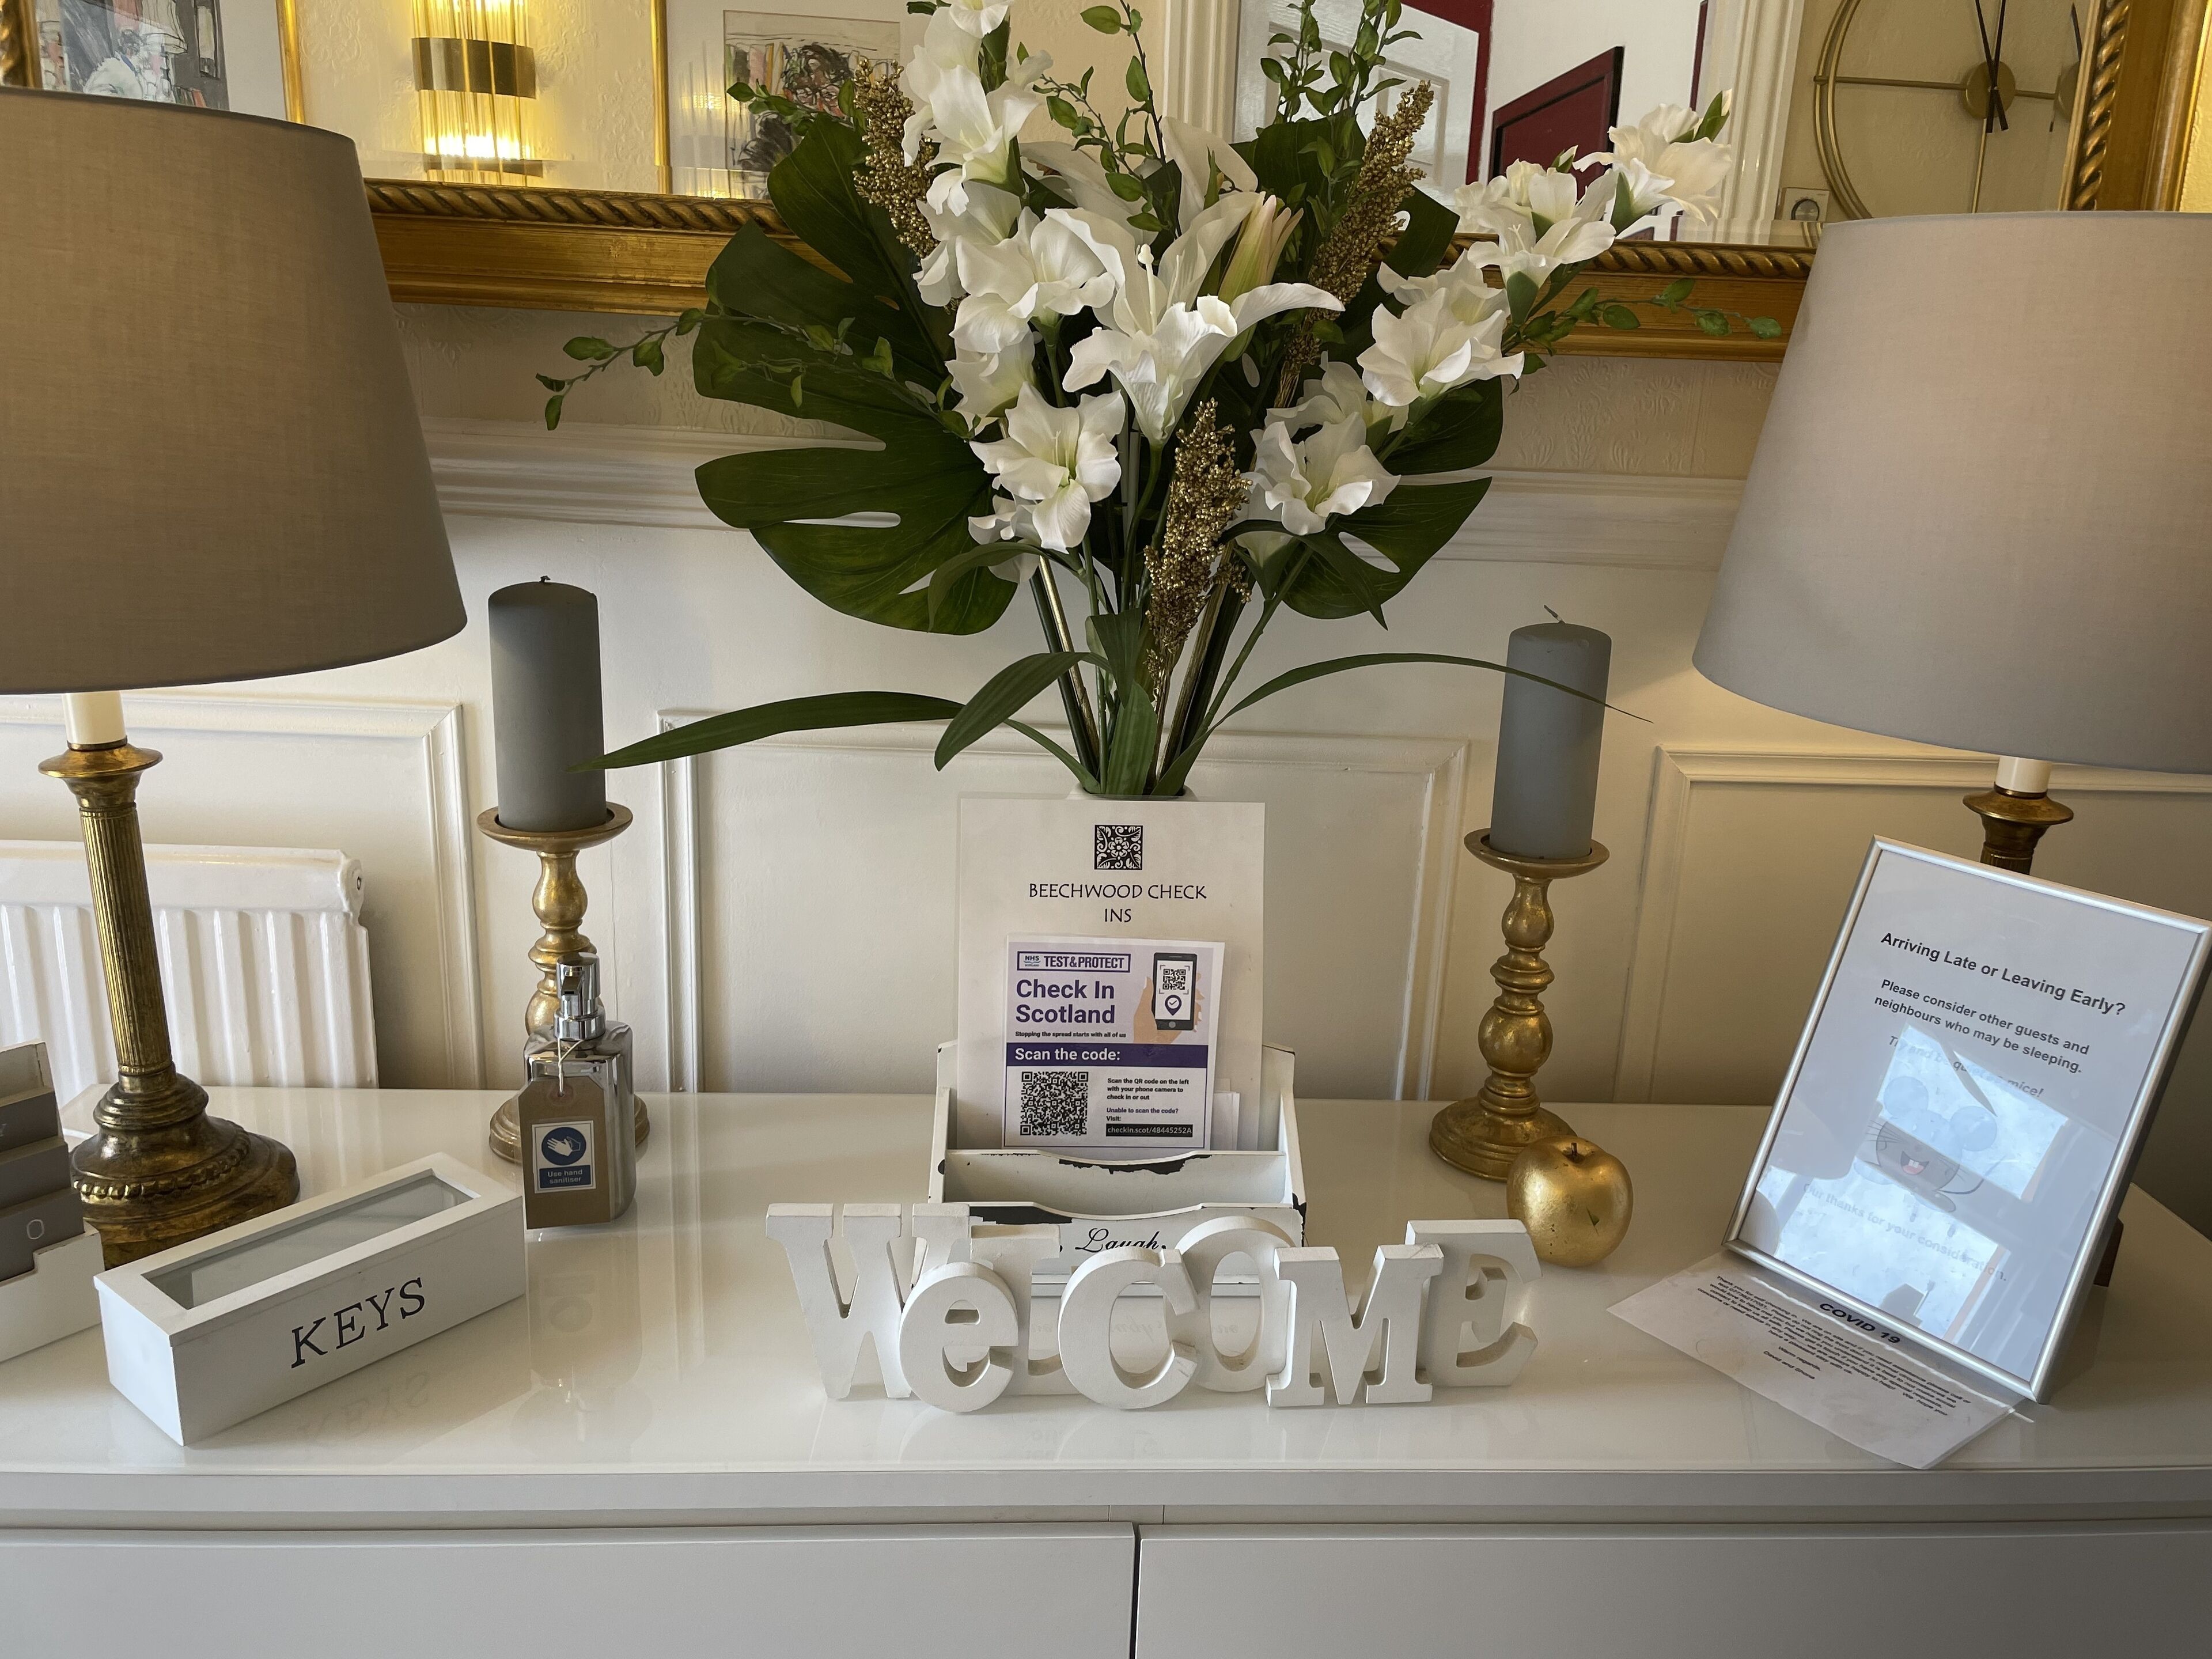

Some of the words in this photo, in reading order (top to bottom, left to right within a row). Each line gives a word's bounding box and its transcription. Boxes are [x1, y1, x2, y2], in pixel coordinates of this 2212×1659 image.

[1029, 883, 1142, 899] BEECHWOOD
[1147, 885, 1207, 899] CHECK
[1105, 908, 1131, 922] INS
[1044, 956, 1124, 969] TEST&PROTECT
[1881, 933, 1940, 961] Arriving
[1944, 951, 1976, 970] Late
[1980, 964, 1998, 976] or
[2001, 968, 2066, 1000] Leaving
[2070, 988, 2126, 1016] Early?
[1016, 979, 1087, 999] Check
[1095, 980, 1114, 999] In
[1016, 1004, 1115, 1024] Scotland
[1881, 979, 1921, 999] Please
[1923, 994, 1976, 1017] consider
[1979, 1011, 2013, 1029] other
[2016, 1024, 2059, 1046] guests
[2063, 1037, 2090, 1055] and
[1874, 996, 1941, 1025] neighbours
[1945, 1018, 1970, 1035] who
[1973, 1029, 2006, 1048] may
[2003, 1037, 2019, 1051] be
[2022, 1046, 2082, 1073] sleeping.
[1015, 1048, 1050, 1060] Scan
[1055, 1048, 1077, 1060] the
[1081, 1049, 1120, 1061] code:
[2008, 1076, 2044, 1097] mice!
[1826, 1193, 1865, 1218] thanks
[290, 1277, 426, 1369] KEYS
[1819, 1303, 1876, 1332] COVID
[1880, 1332, 1900, 1344] 19
